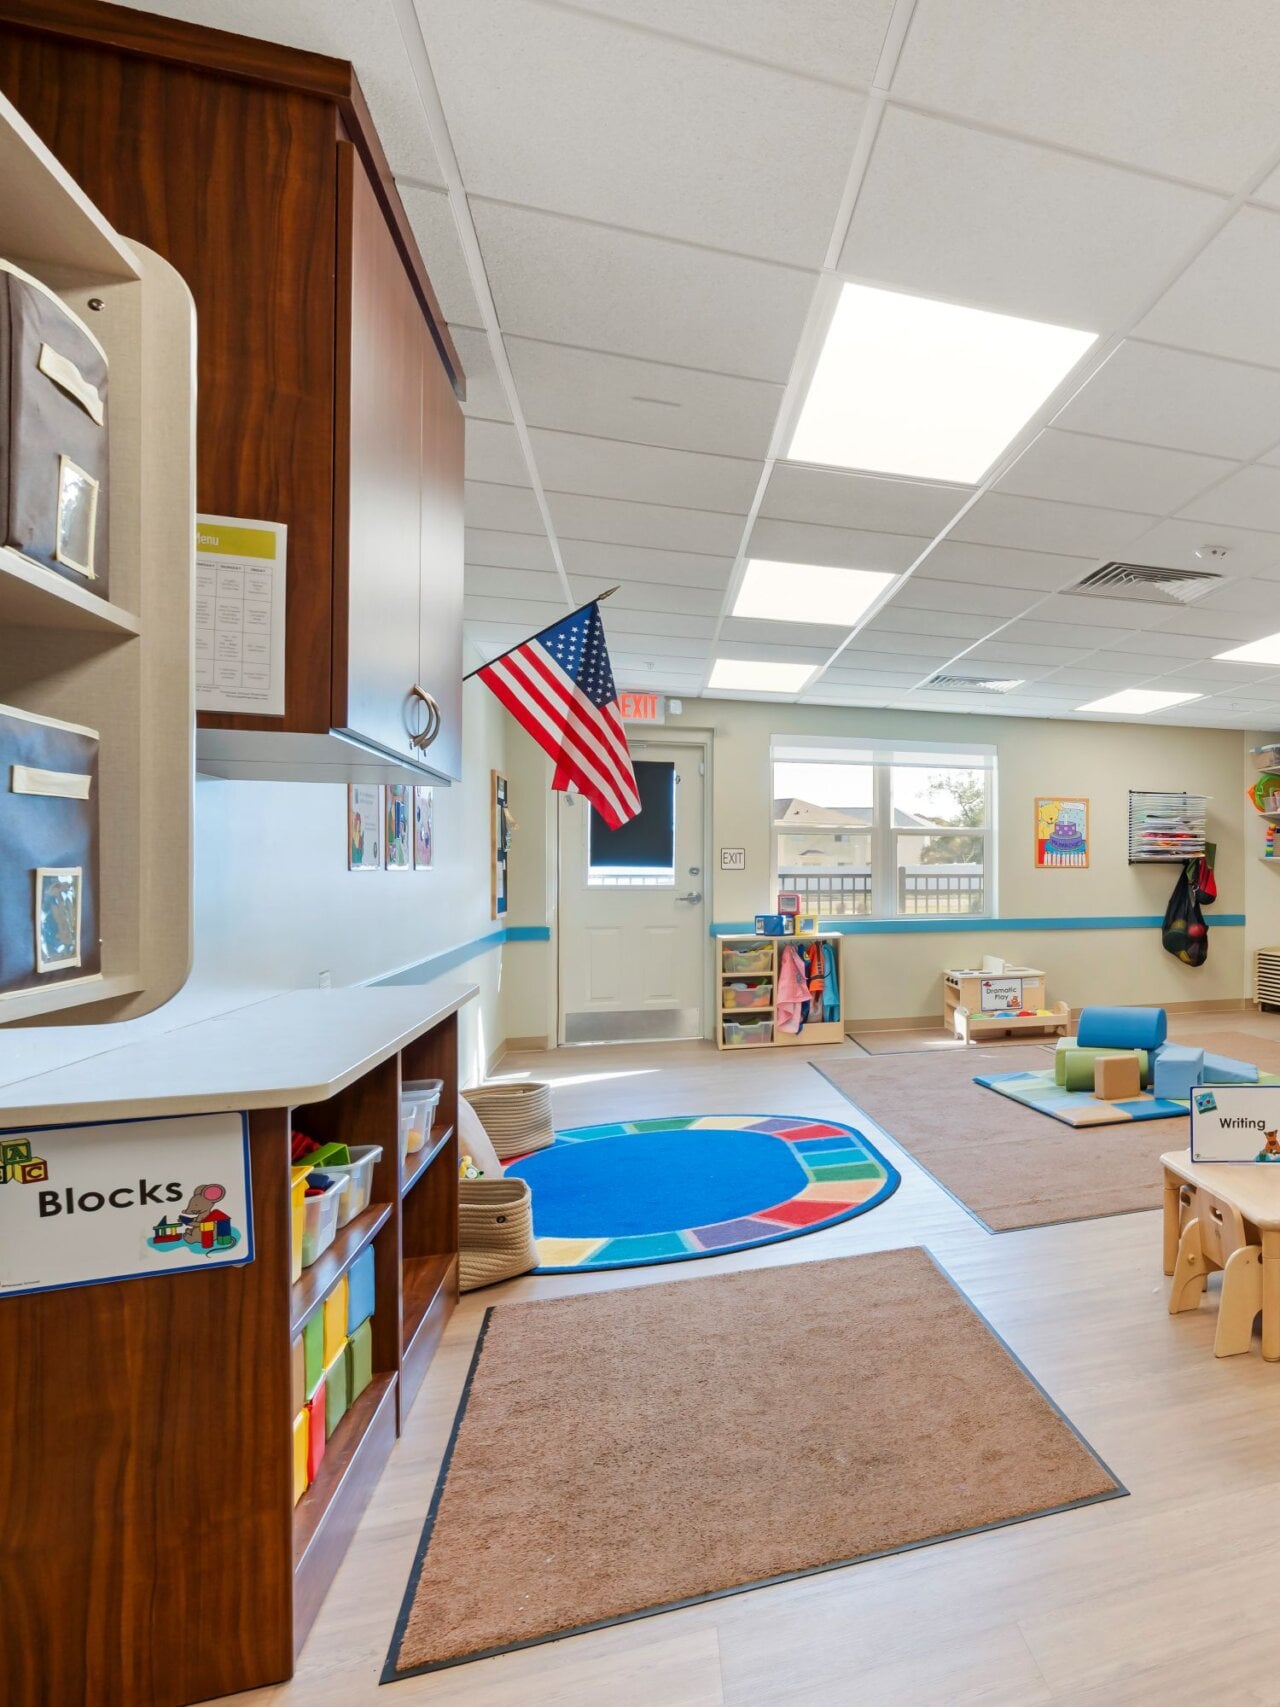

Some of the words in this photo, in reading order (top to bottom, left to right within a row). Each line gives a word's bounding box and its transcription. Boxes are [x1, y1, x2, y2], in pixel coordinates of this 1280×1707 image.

[621, 693, 659, 720] EXIT
[723, 852, 743, 865] EXIT
[986, 986, 1017, 995] Dramatic
[1219, 1117, 1266, 1131] Writing
[7, 1145, 28, 1161] A
[26, 1166, 43, 1178] C
[38, 1179, 183, 1218] Blocks
